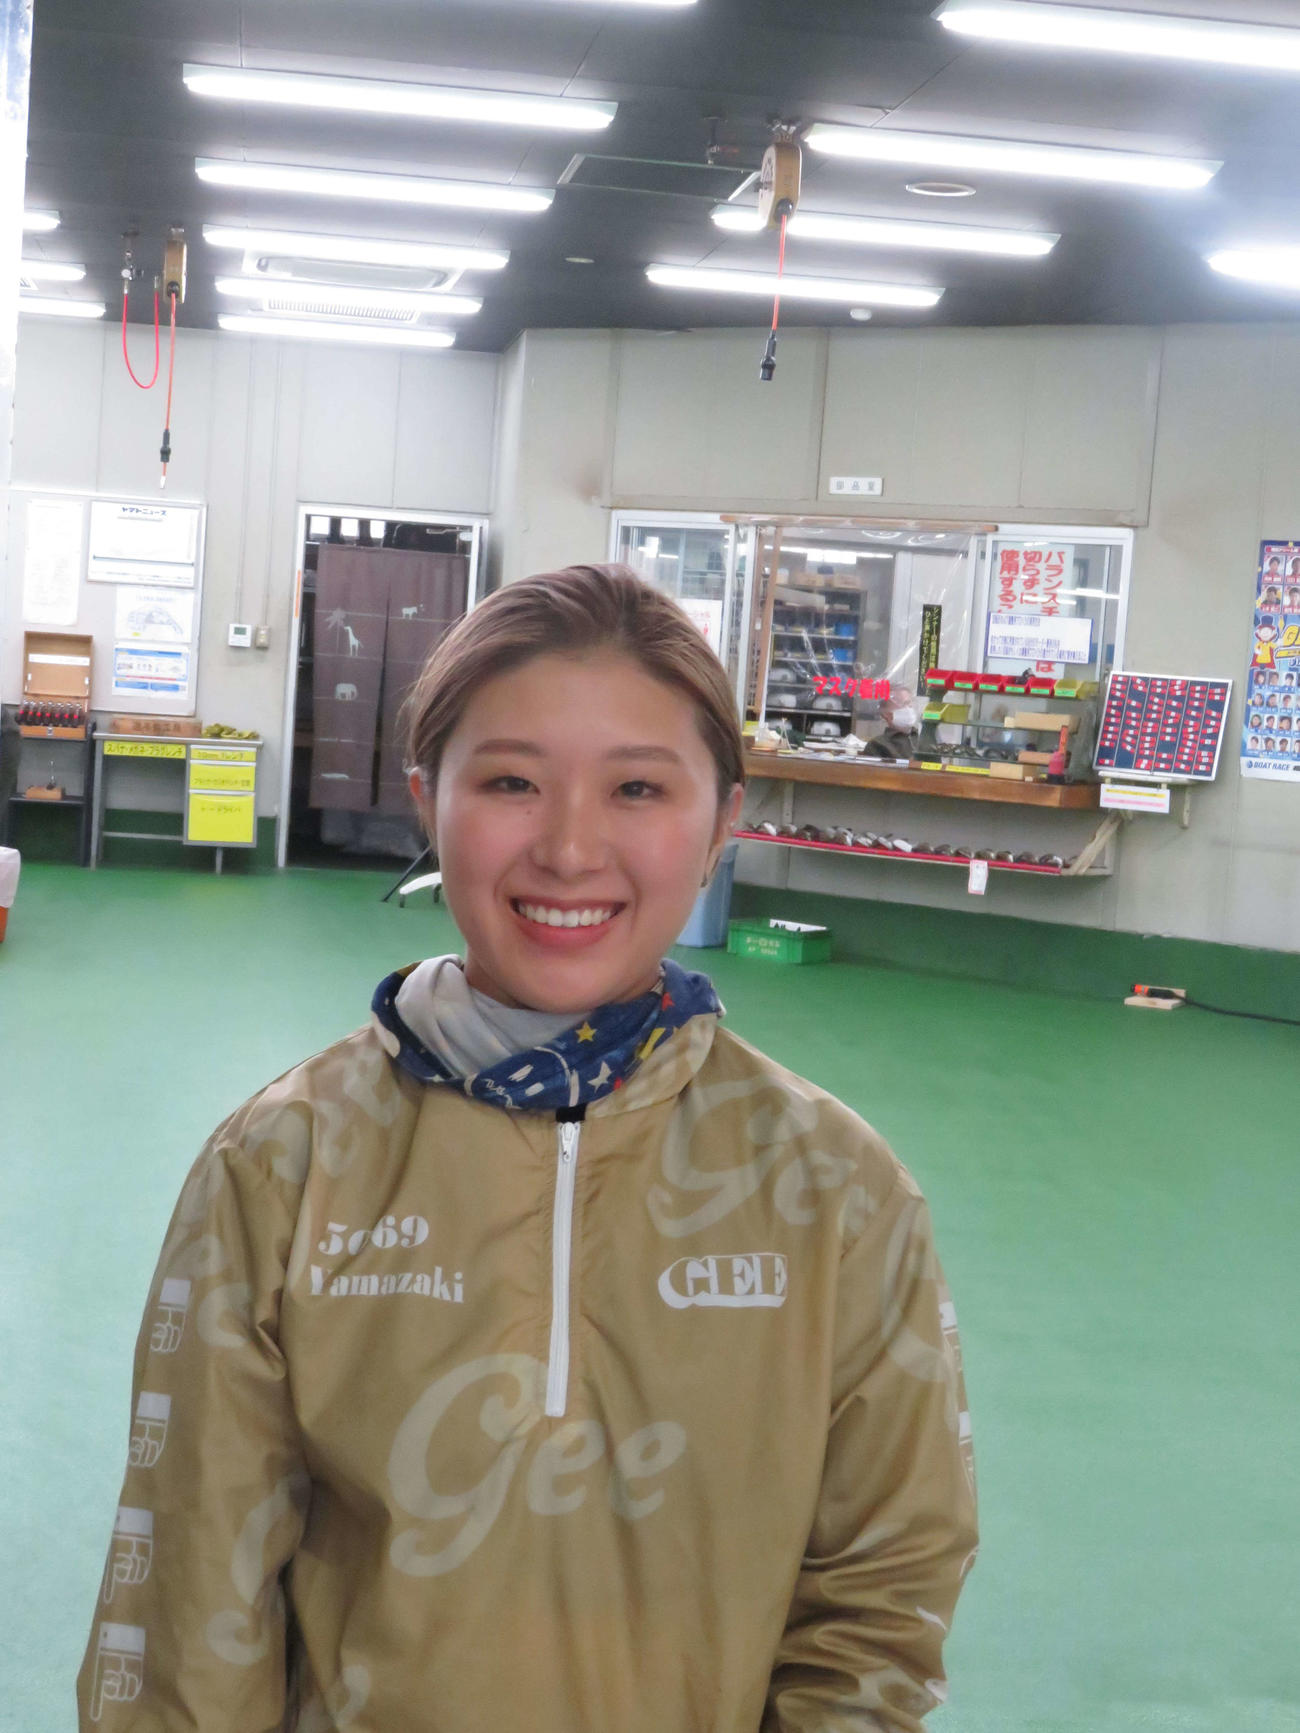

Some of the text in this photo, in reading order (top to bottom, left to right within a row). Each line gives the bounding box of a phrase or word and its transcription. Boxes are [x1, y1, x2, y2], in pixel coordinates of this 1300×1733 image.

[1020, 550, 1042, 604] 切らずに
[812, 675, 890, 702] マスク着用
[1253, 761, 1271, 769] BOAT
[309, 1264, 464, 1303] Yamazaki
[658, 1252, 788, 1309] GEE
[387, 1353, 687, 1577] Gee
